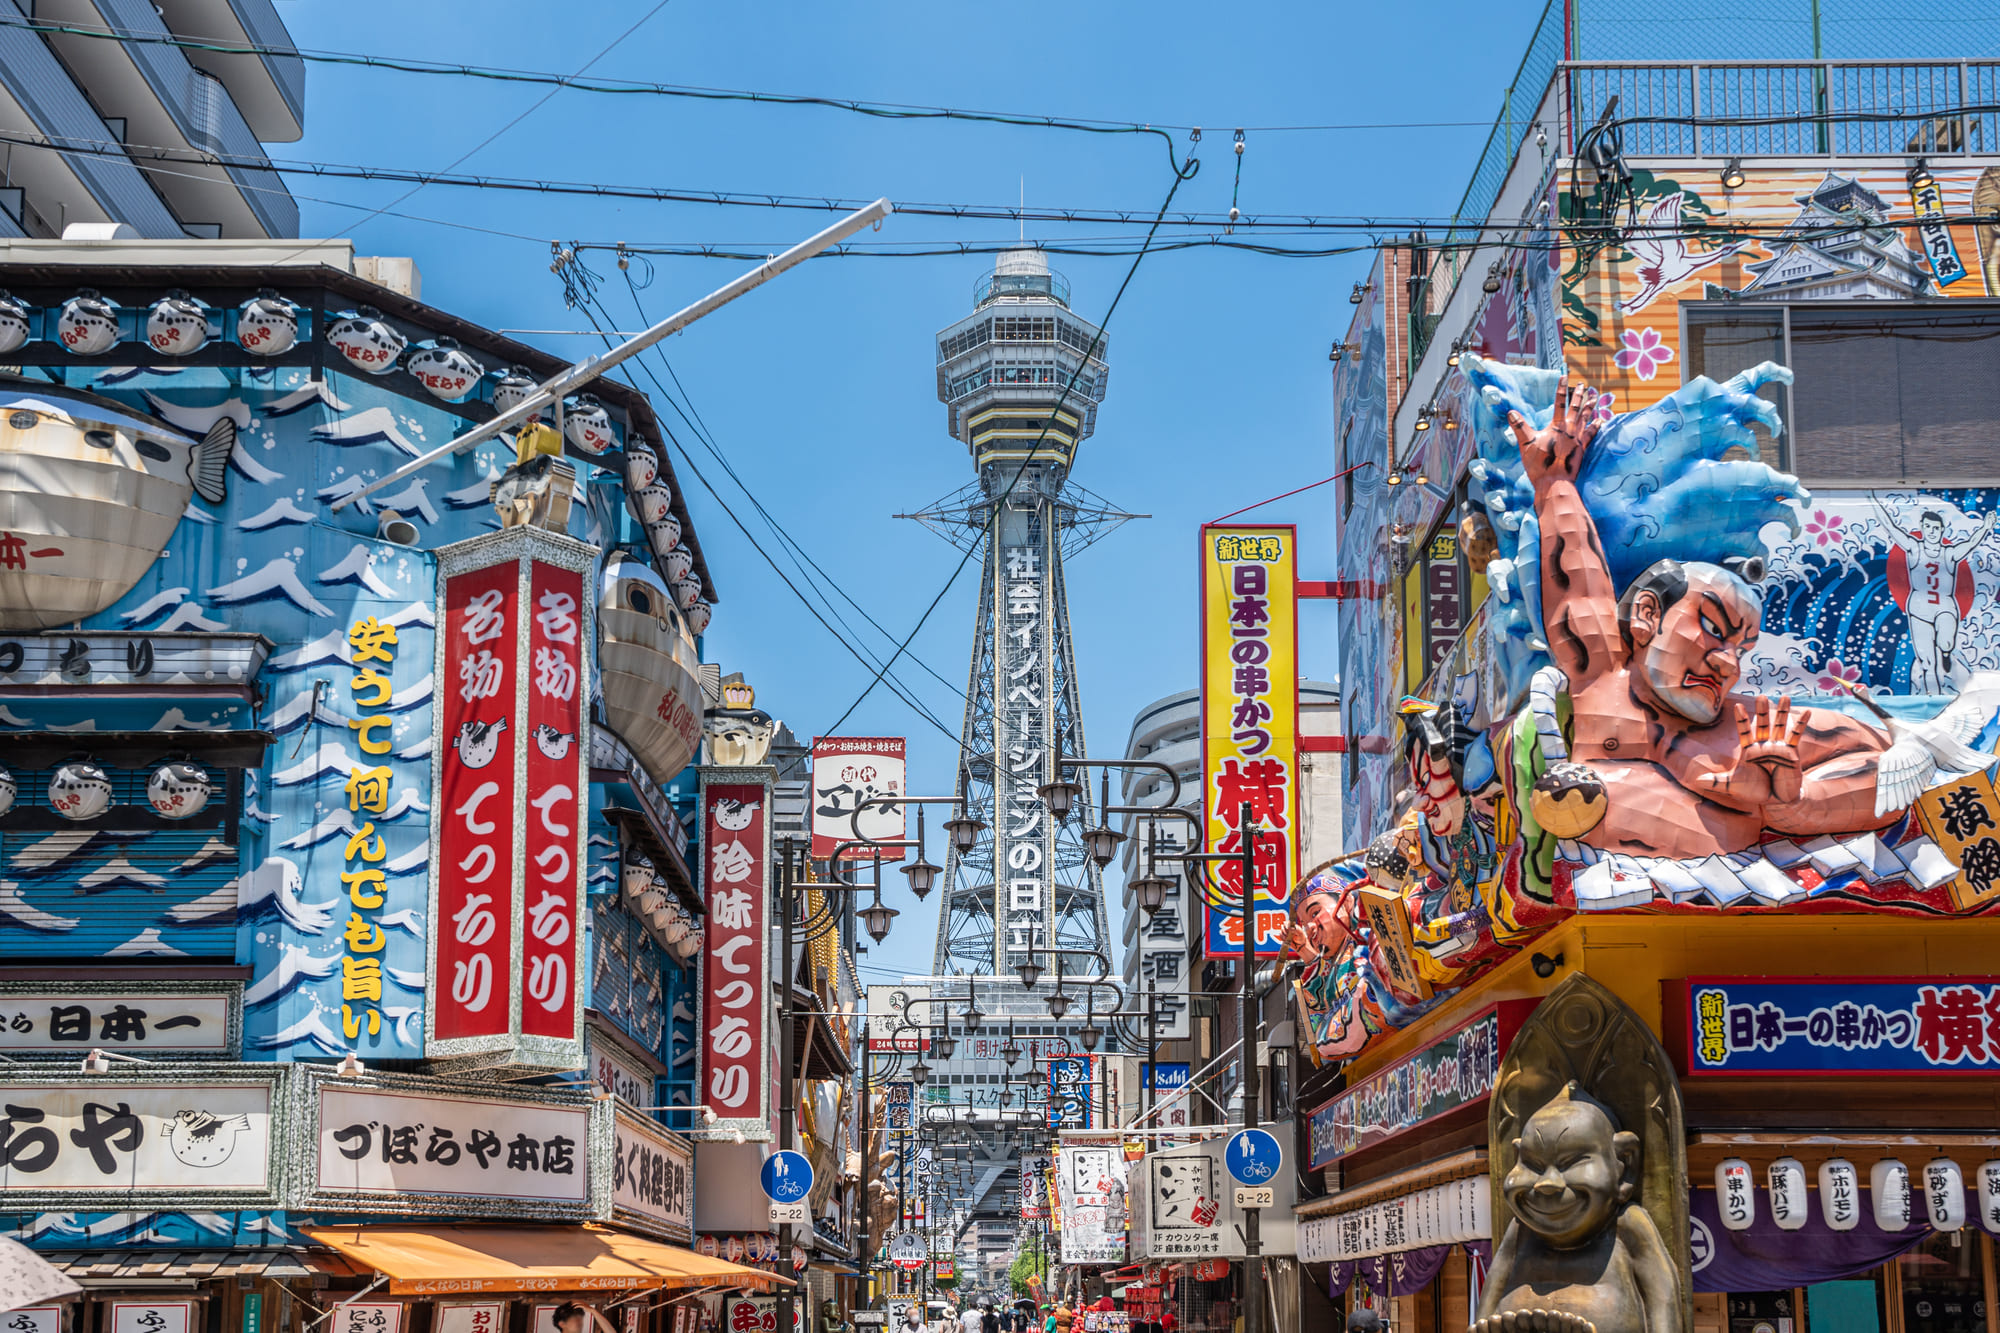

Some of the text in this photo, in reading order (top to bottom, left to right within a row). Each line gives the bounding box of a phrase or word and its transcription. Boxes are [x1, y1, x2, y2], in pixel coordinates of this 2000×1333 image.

[1916, 187, 1961, 277] 千客万来
[1218, 537, 1281, 561] 新世界
[1925, 561, 1940, 605] グリコ
[1231, 564, 1270, 754] 日本一の串かつ
[1006, 547, 1042, 951] 社会イノベーションの日立
[452, 590, 504, 1012] 名物 てっちり
[528, 589, 578, 1013] 名物 てっちり
[341, 616, 398, 1040] 安うて何んでも旨い
[1217, 760, 1289, 903] 横綱
[709, 841, 760, 1108] 珍味てっちり
[0, 1005, 201, 1041] ら日本一
[1700, 988, 2000, 1062] 新世界 日本一の串かつ 横
[888, 1084, 911, 1126] 麻雀
[334, 1121, 576, 1175] づぼらや本店
[1828, 1165, 1850, 1174] 串かつ
[1927, 1166, 1948, 1175] 串かつ
[614, 1133, 686, 1217] ふぐ料理専門
[1772, 1175, 1789, 1221] 豚バラ
[1832, 1175, 1851, 1222] ホルモン
[1727, 1178, 1747, 1222] 串かつ
[1929, 1175, 1949, 1223] 砂ずり
[1153, 1244, 1219, 1253] 2F 座敷あります
[1166, 1233, 1219, 1241] カウンター席
[732, 1301, 778, 1333] 串か
